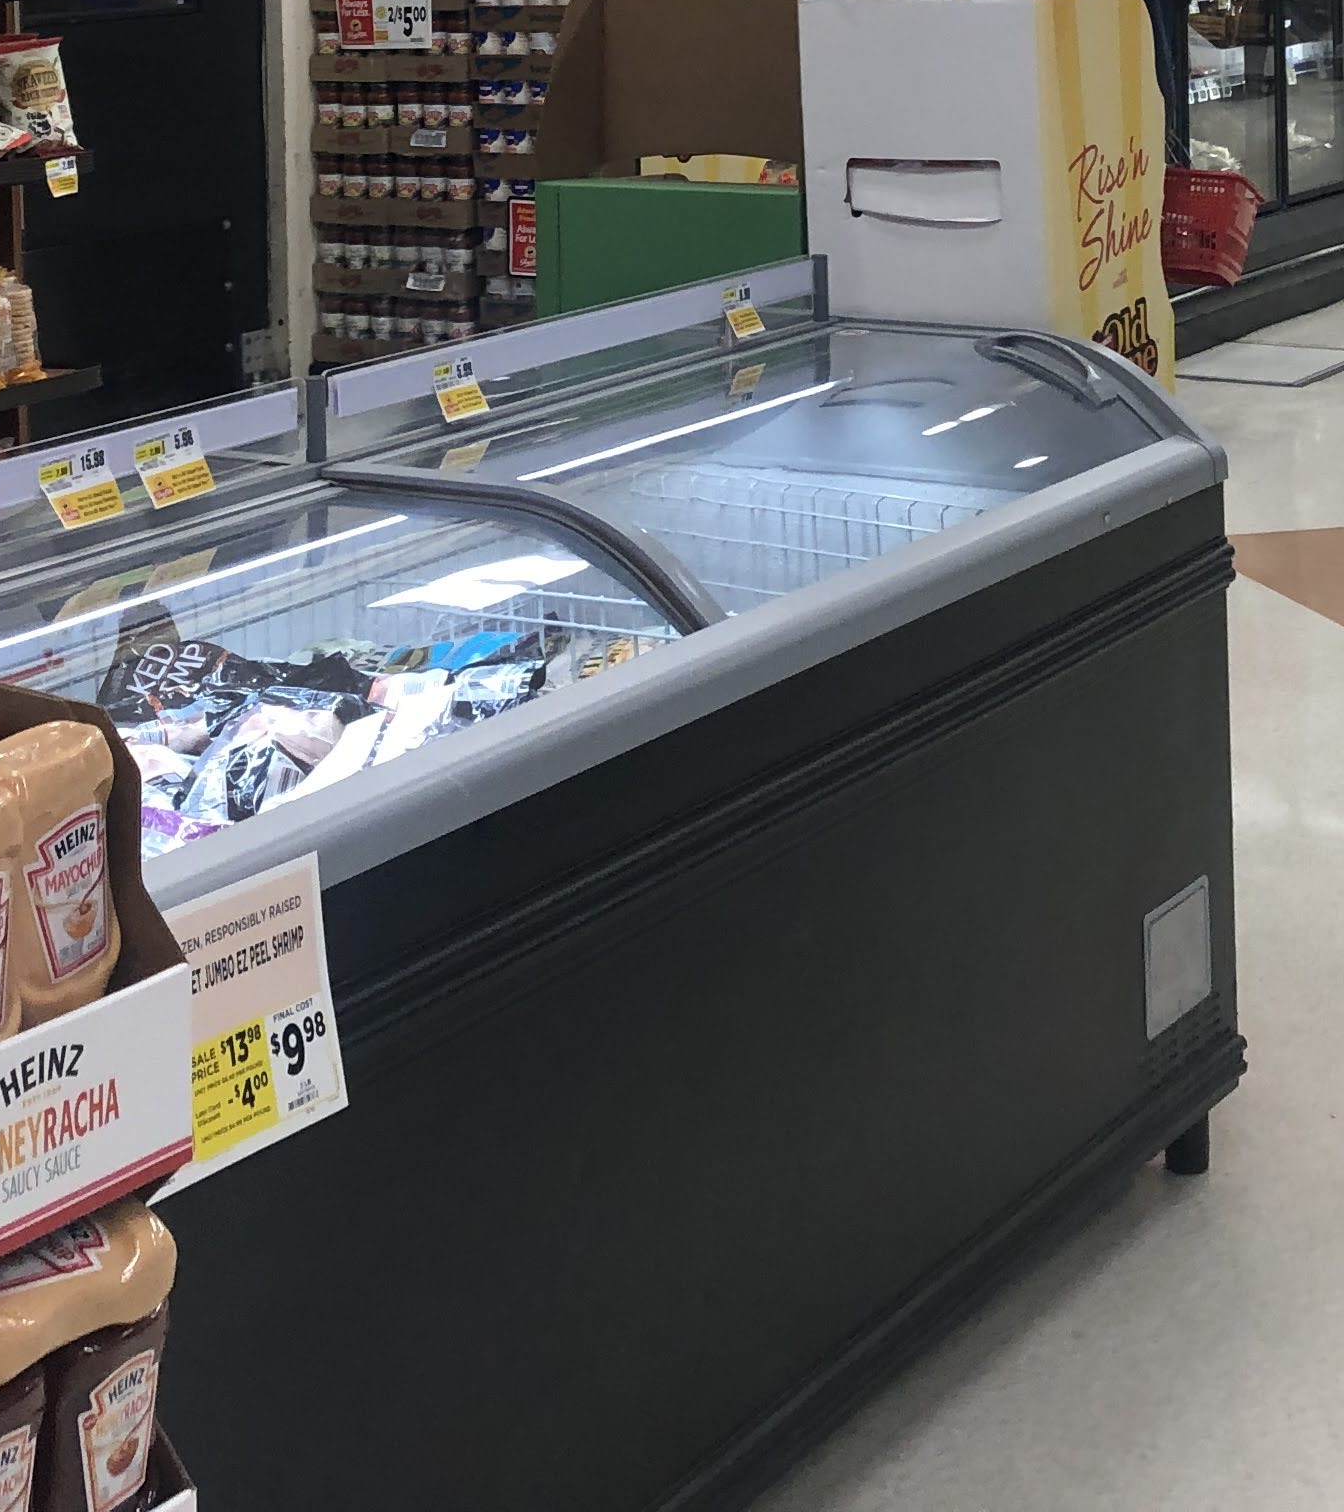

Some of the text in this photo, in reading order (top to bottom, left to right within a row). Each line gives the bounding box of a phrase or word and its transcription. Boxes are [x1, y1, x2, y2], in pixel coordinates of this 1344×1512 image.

[1079, 200, 1152, 291] Shine
[54, 822, 96, 860] HEINZ
[44, 845, 102, 896] MAYOCHUP
[205, 909, 266, 946] RESPONSIBLY
[269, 895, 302, 919] RAISED
[205, 954, 234, 989] JUMBO
[237, 948, 248, 974] EZ
[250, 940, 271, 969] PEEL
[272, 925, 304, 959] SHRIMP
[273, 998, 313, 1023] FINAL COST
[191, 1048, 216, 1068] SALE
[191, 1062, 220, 1083] PRICE
[1, 1144, 82, 1204] SAUCY SAUCE
[108, 1367, 145, 1404] HEINZ
